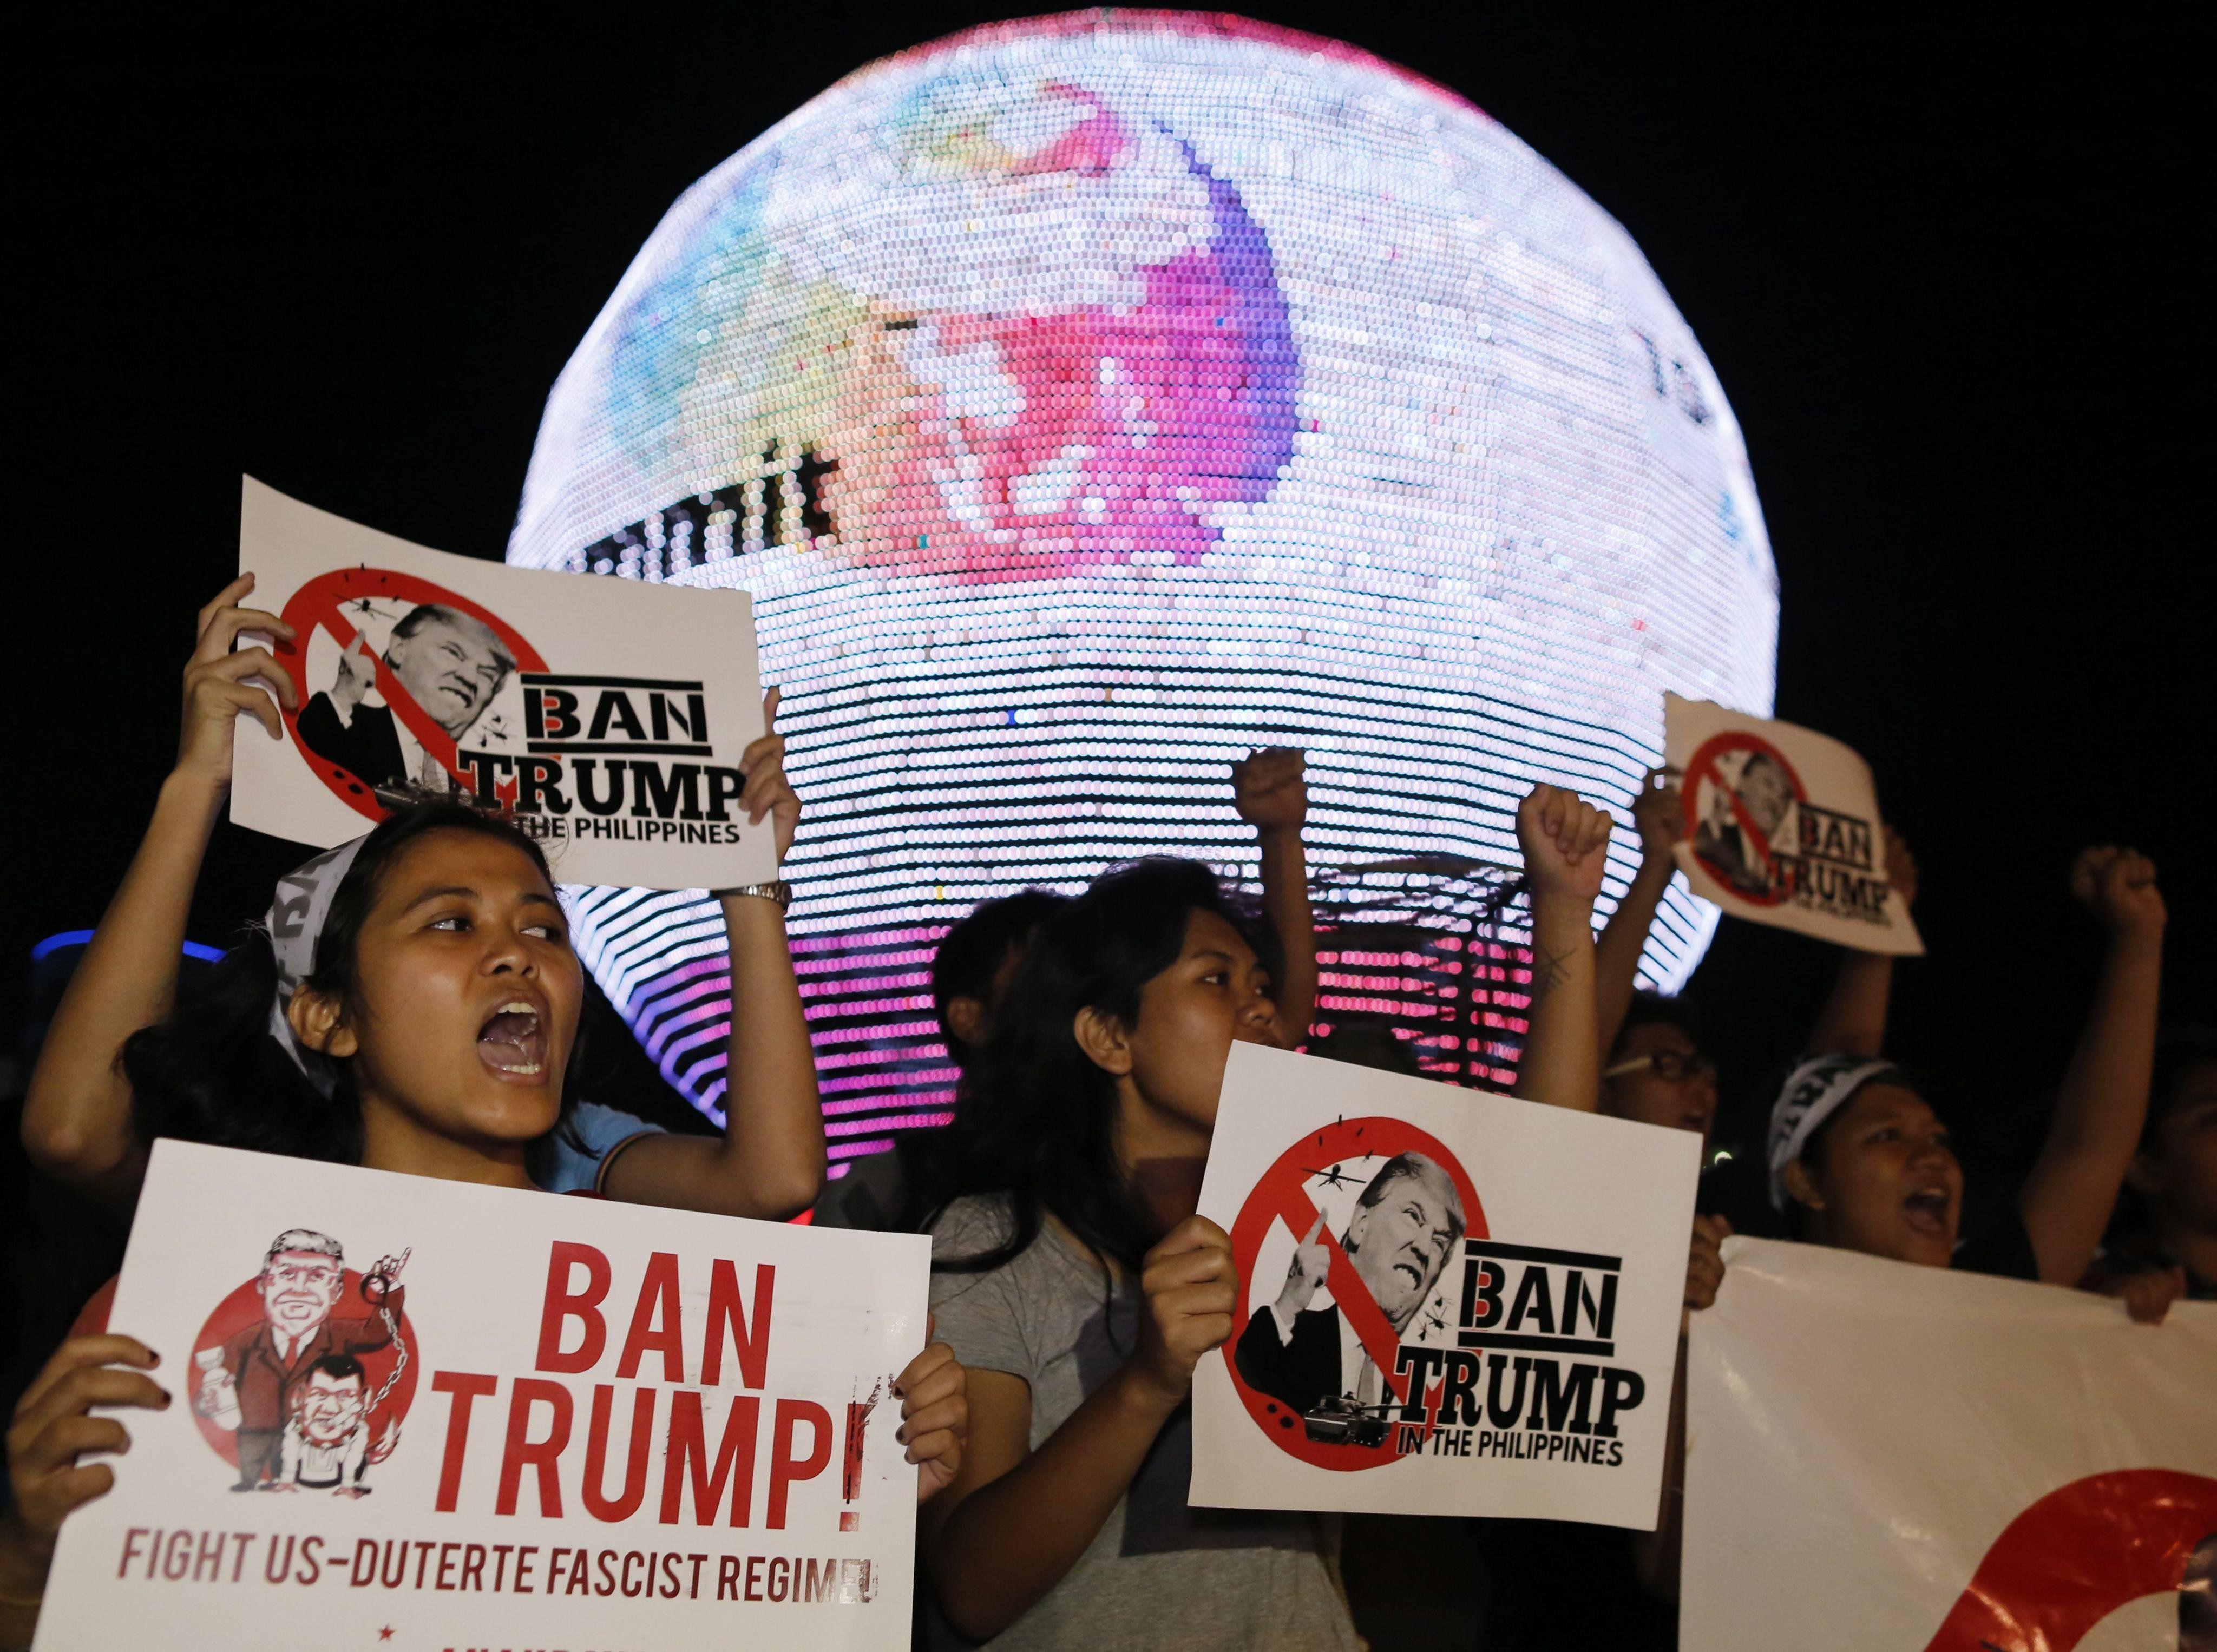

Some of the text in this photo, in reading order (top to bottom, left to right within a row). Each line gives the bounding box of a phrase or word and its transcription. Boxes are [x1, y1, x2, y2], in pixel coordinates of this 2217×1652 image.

[565, 436, 839, 578] mmit
[523, 688, 708, 742] BAN
[458, 749, 747, 821] TRUMP
[575, 818, 740, 844] PHILIPPINES
[1798, 811, 1872, 868] BAN
[1770, 851, 1888, 914] TRUMP
[535, 1240, 776, 1390] BAN
[1459, 1259, 1618, 1339] BAN
[1395, 1345, 1645, 1438] TRUMP
[431, 1370, 868, 1532] TRUMP!
[1397, 1426, 1624, 1467] IN THE PHILIPPINES
[114, 1526, 257, 1584] FIGHT
[263, 1534, 540, 1594] US-DUTERTE
[546, 1546, 708, 1600] FASCIST
